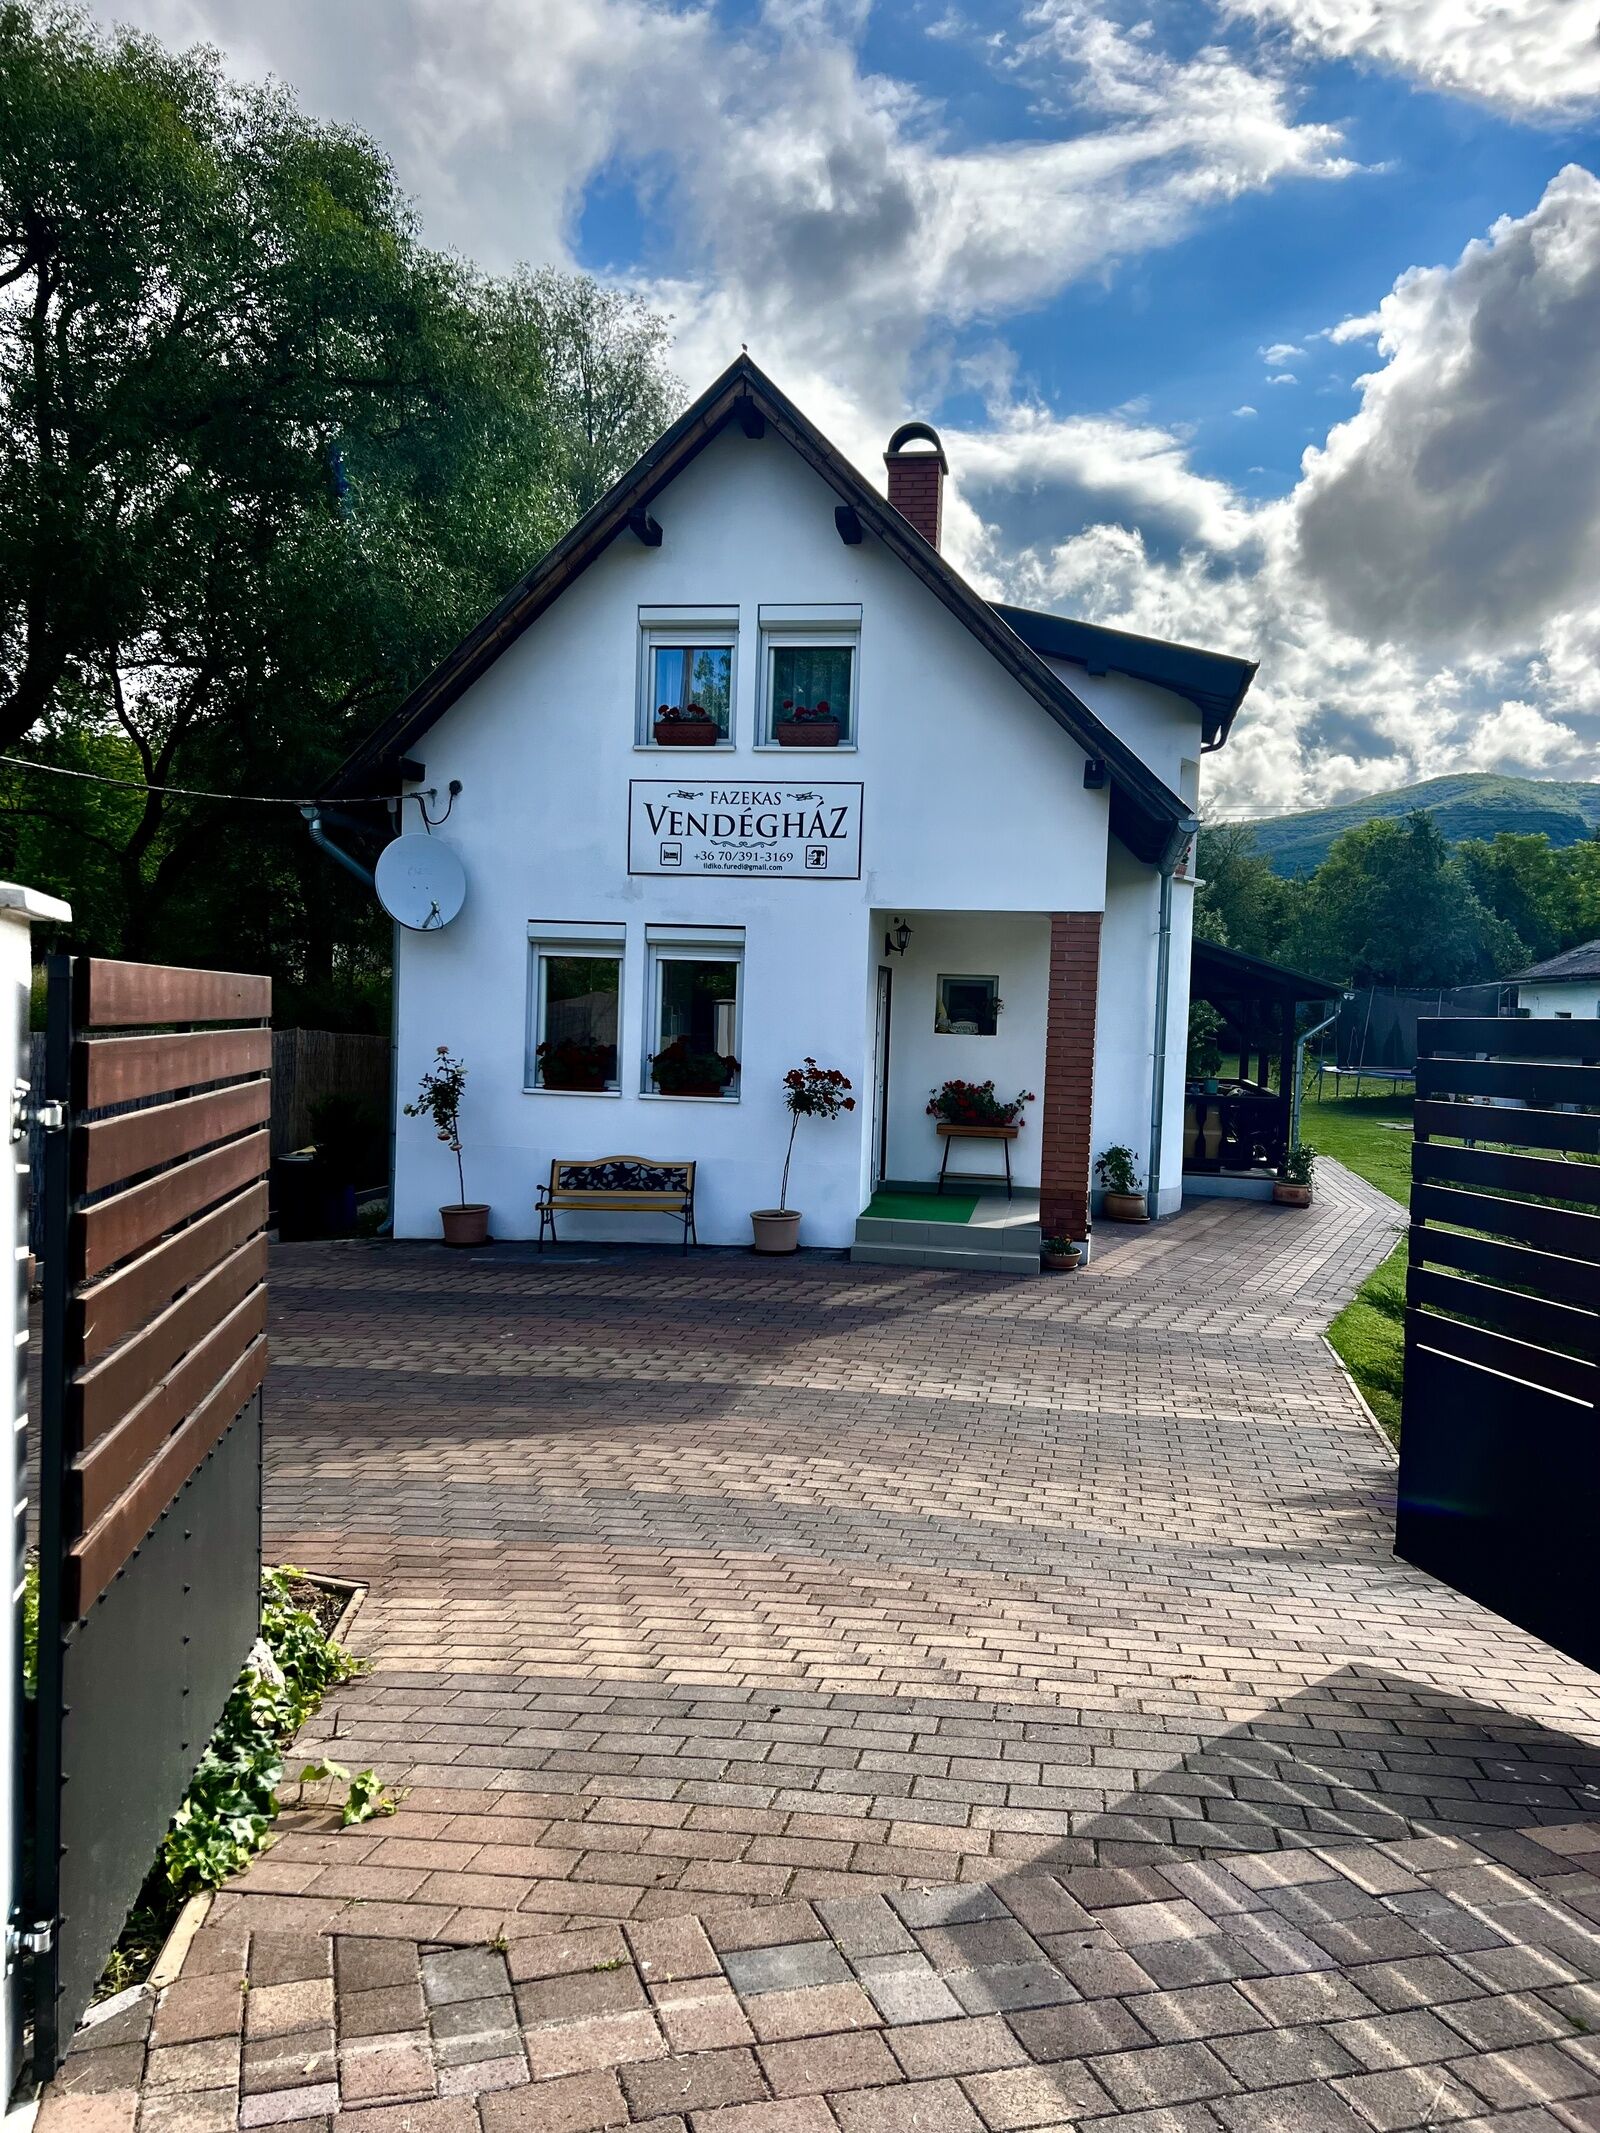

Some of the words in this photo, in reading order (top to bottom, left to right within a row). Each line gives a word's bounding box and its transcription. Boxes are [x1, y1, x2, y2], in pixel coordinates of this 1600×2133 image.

[710, 791, 782, 806] FAZEKAS
[643, 800, 849, 839] VENDÉGHÁZ
[694, 851, 715, 861] +36
[718, 851, 793, 862] 70/391-3169
